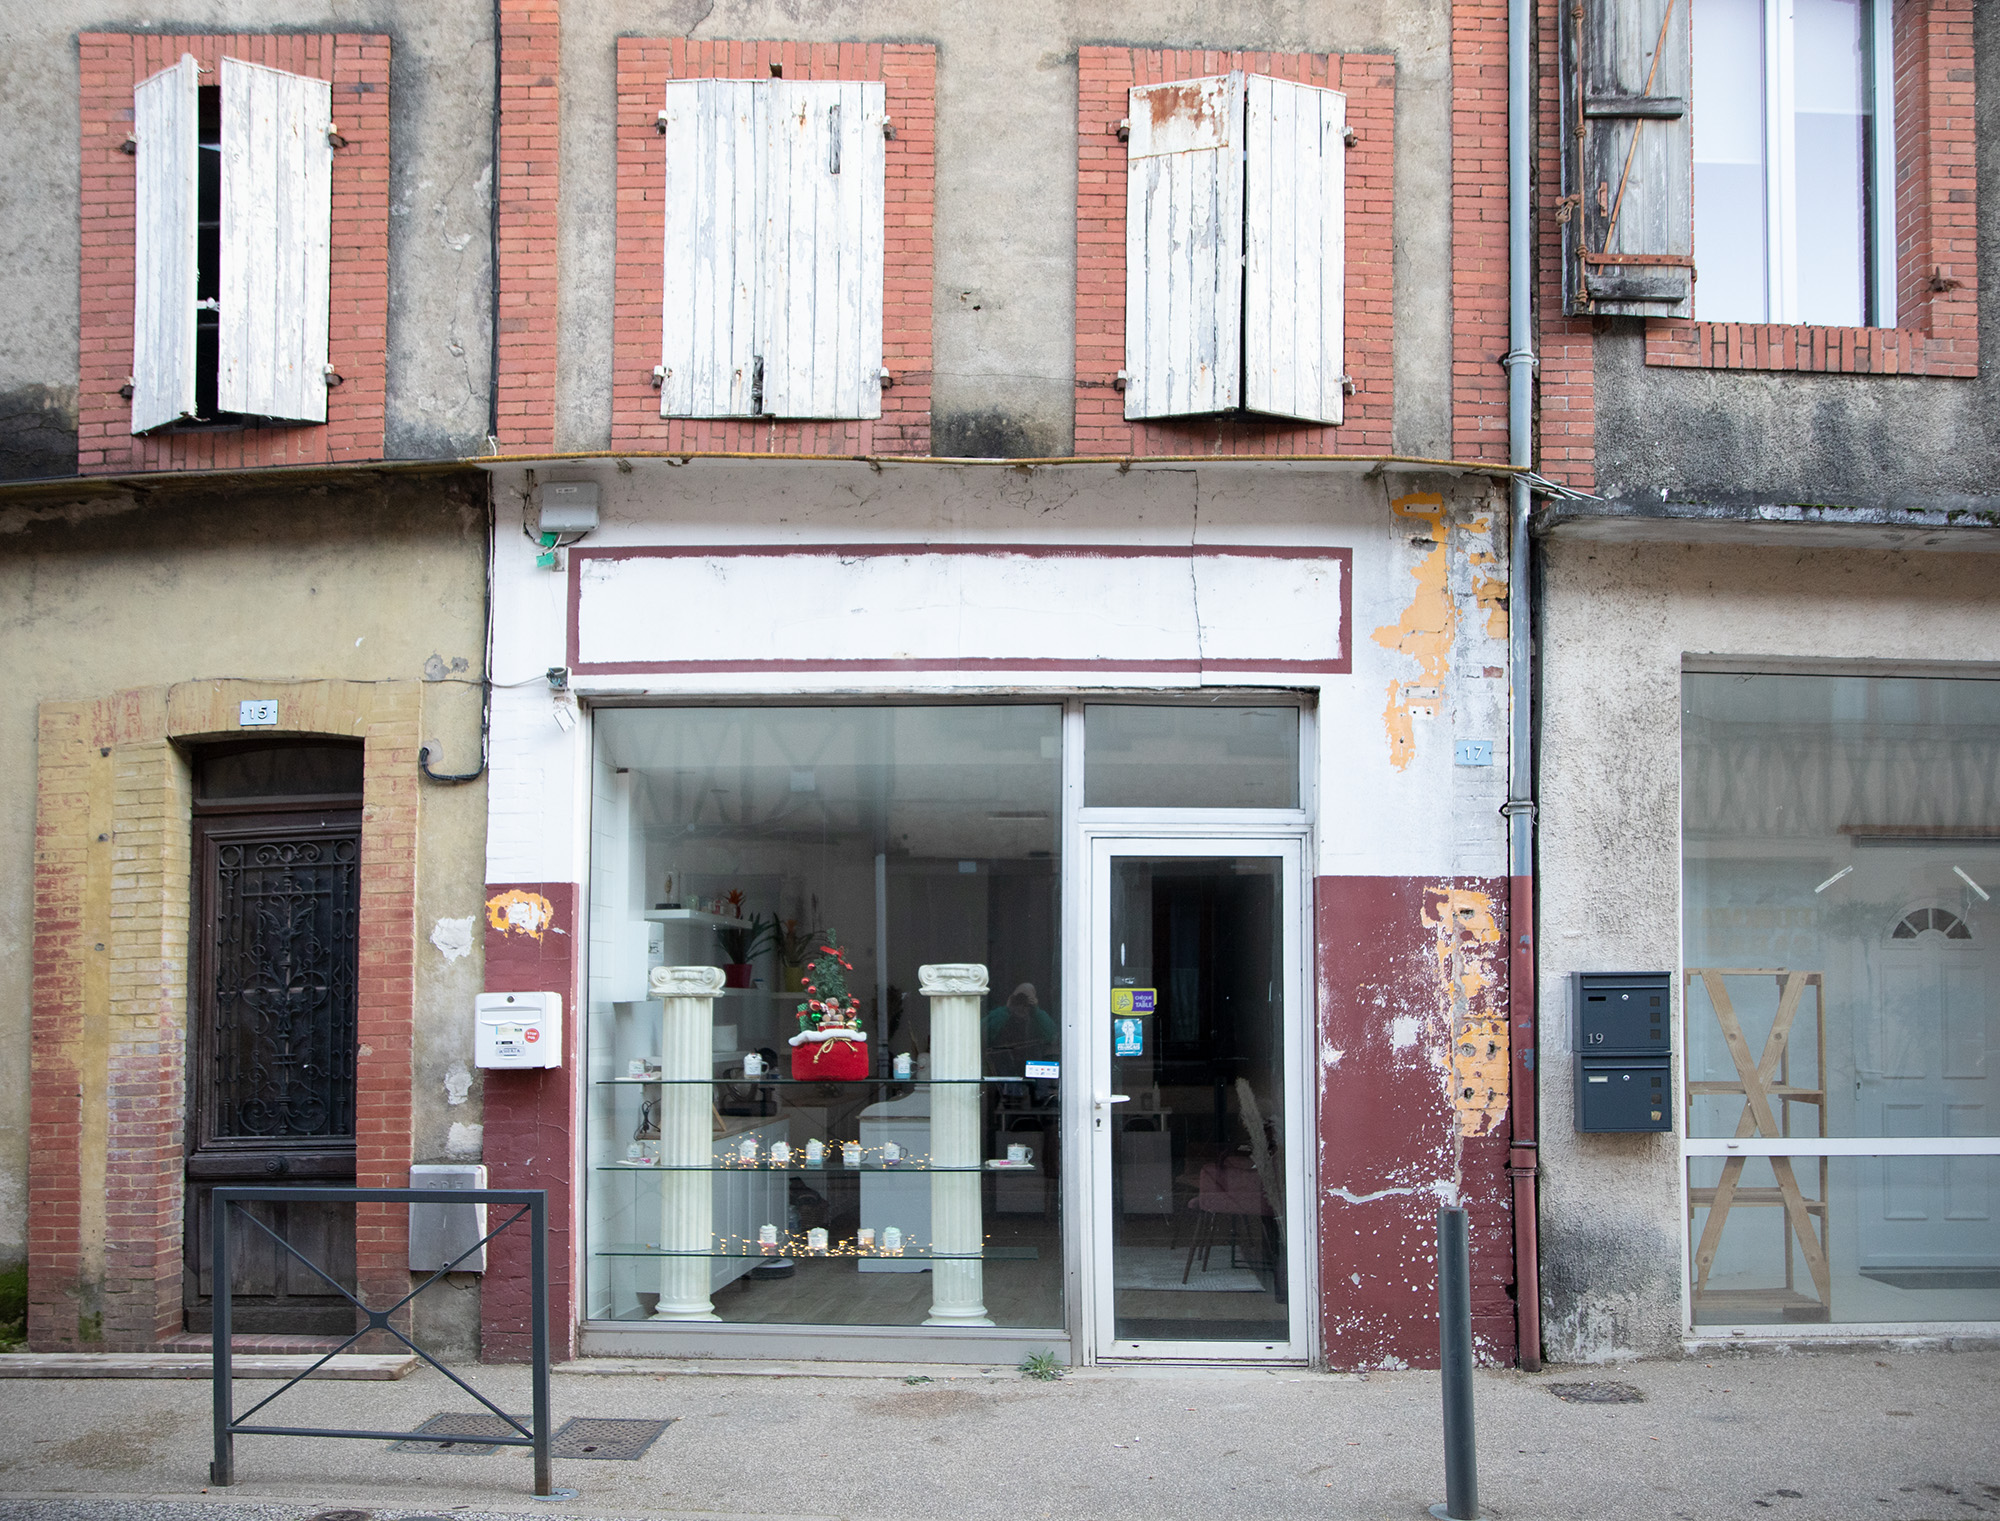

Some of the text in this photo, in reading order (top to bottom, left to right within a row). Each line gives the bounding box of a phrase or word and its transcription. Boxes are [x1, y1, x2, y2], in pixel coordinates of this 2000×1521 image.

[249, 705, 268, 720] 15
[1465, 746, 1484, 760] 17
[1587, 1032, 1604, 1044] 19
